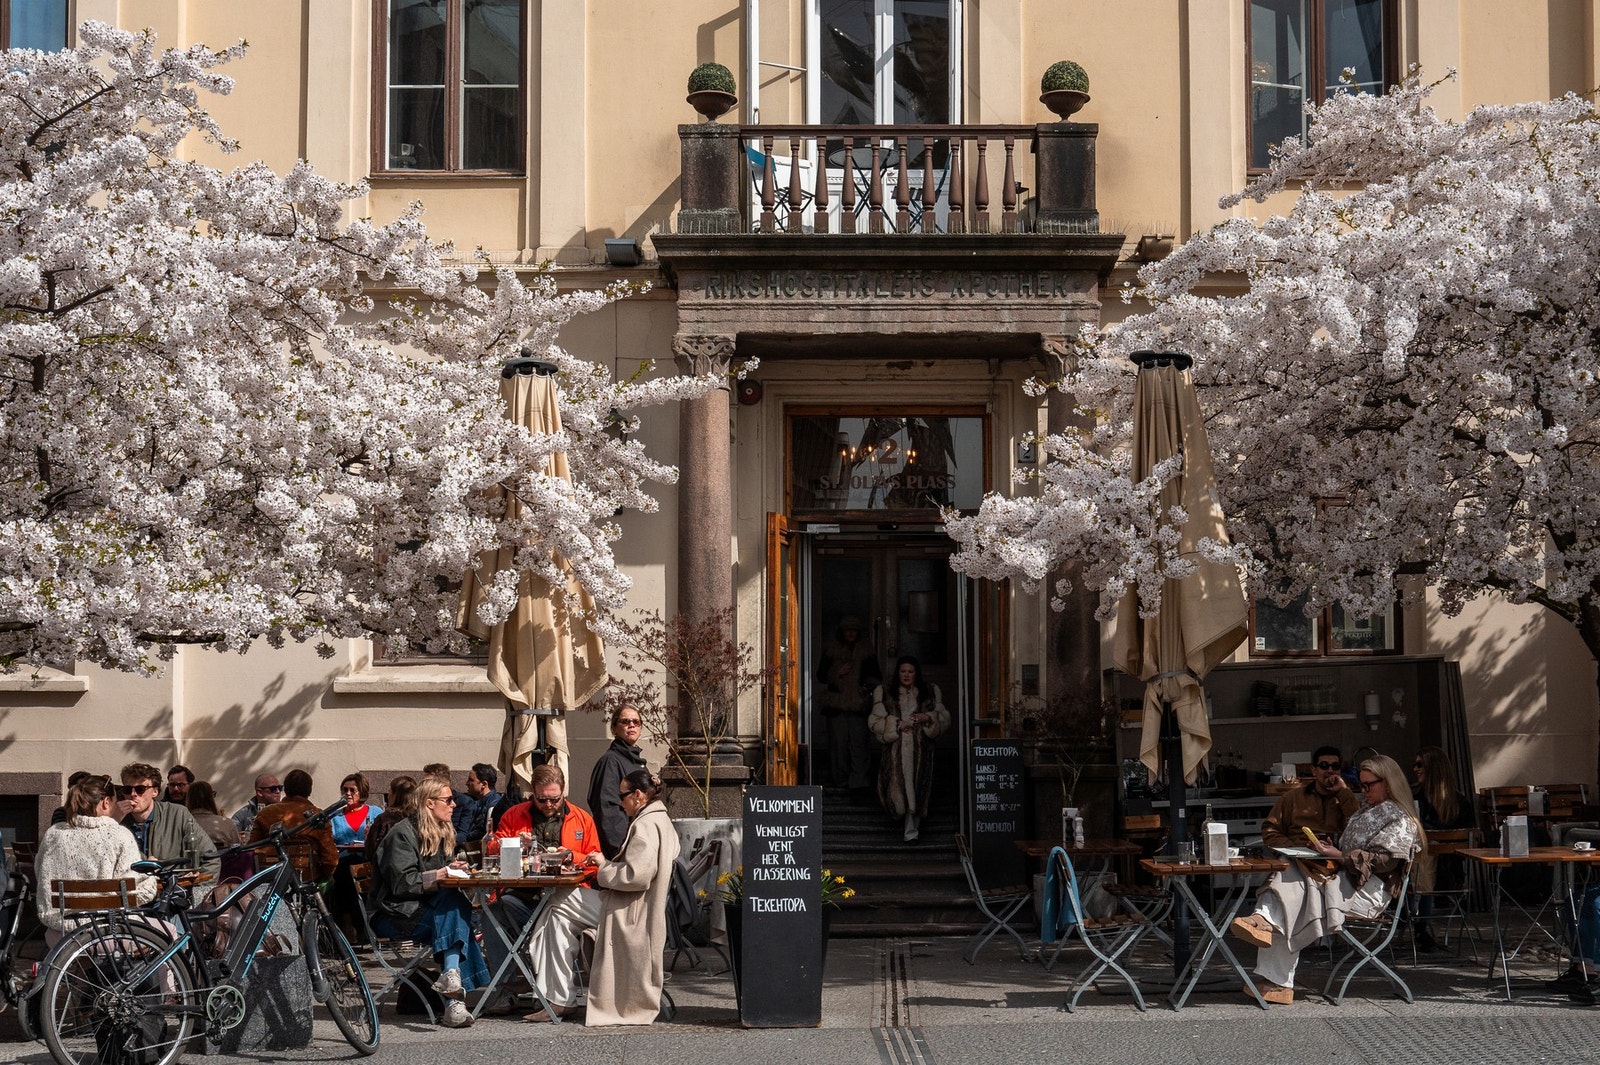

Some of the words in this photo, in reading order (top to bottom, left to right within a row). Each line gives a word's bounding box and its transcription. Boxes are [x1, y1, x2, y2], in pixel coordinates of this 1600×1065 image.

[705, 273, 937, 299] RIKSHOSPITALETS
[951, 273, 1068, 298] APOTHEK
[877, 437, 898, 465] 2
[906, 475, 957, 491] PLASS
[973, 746, 1019, 757] TEKEHTOPA
[749, 796, 814, 813] VELKOMMEN!
[755, 824, 808, 838] VENNLIGST
[768, 840, 794, 852] VENT
[762, 853, 780, 865] HER
[784, 851, 796, 865] PÅ
[753, 867, 811, 881] PLASSERING
[261, 892, 280, 922] buddy
[749, 896, 807, 912] TEKEHTOPA
